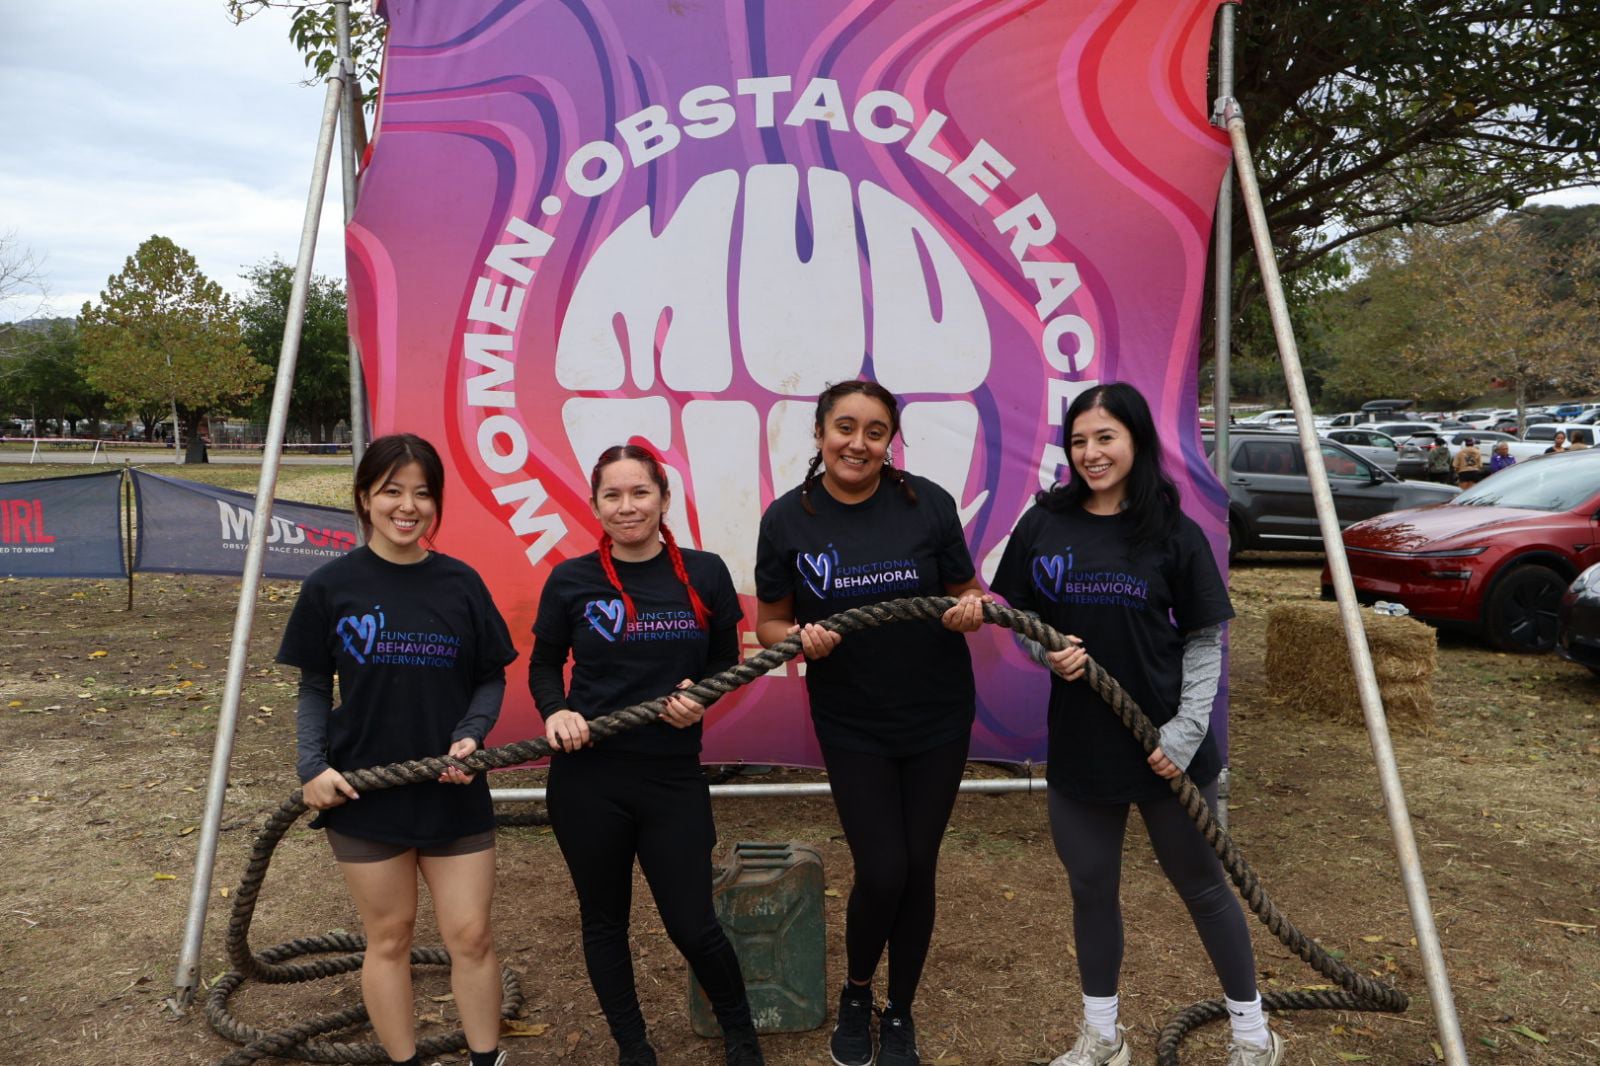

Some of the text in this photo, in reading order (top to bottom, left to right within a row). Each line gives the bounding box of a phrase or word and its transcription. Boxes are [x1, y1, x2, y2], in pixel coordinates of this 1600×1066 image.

[565, 75, 1016, 206] OBSTACLE
[993, 192, 1099, 426] RACE
[555, 163, 992, 397] MUD
[269, 546, 291, 554] RACE
[293, 548, 341, 557] DEDICATED
[836, 558, 918, 575] FUNCTIONAL
[834, 569, 919, 588] BEHAVIORAL
[1067, 571, 1148, 590] FUNCTIONAL
[1065, 582, 1147, 599] BEHAVIORAL
[626, 619, 700, 632] BEHAVIOR
[380, 631, 461, 646] FUNCTIONAL
[376, 641, 458, 657] BEHAVIORAL
